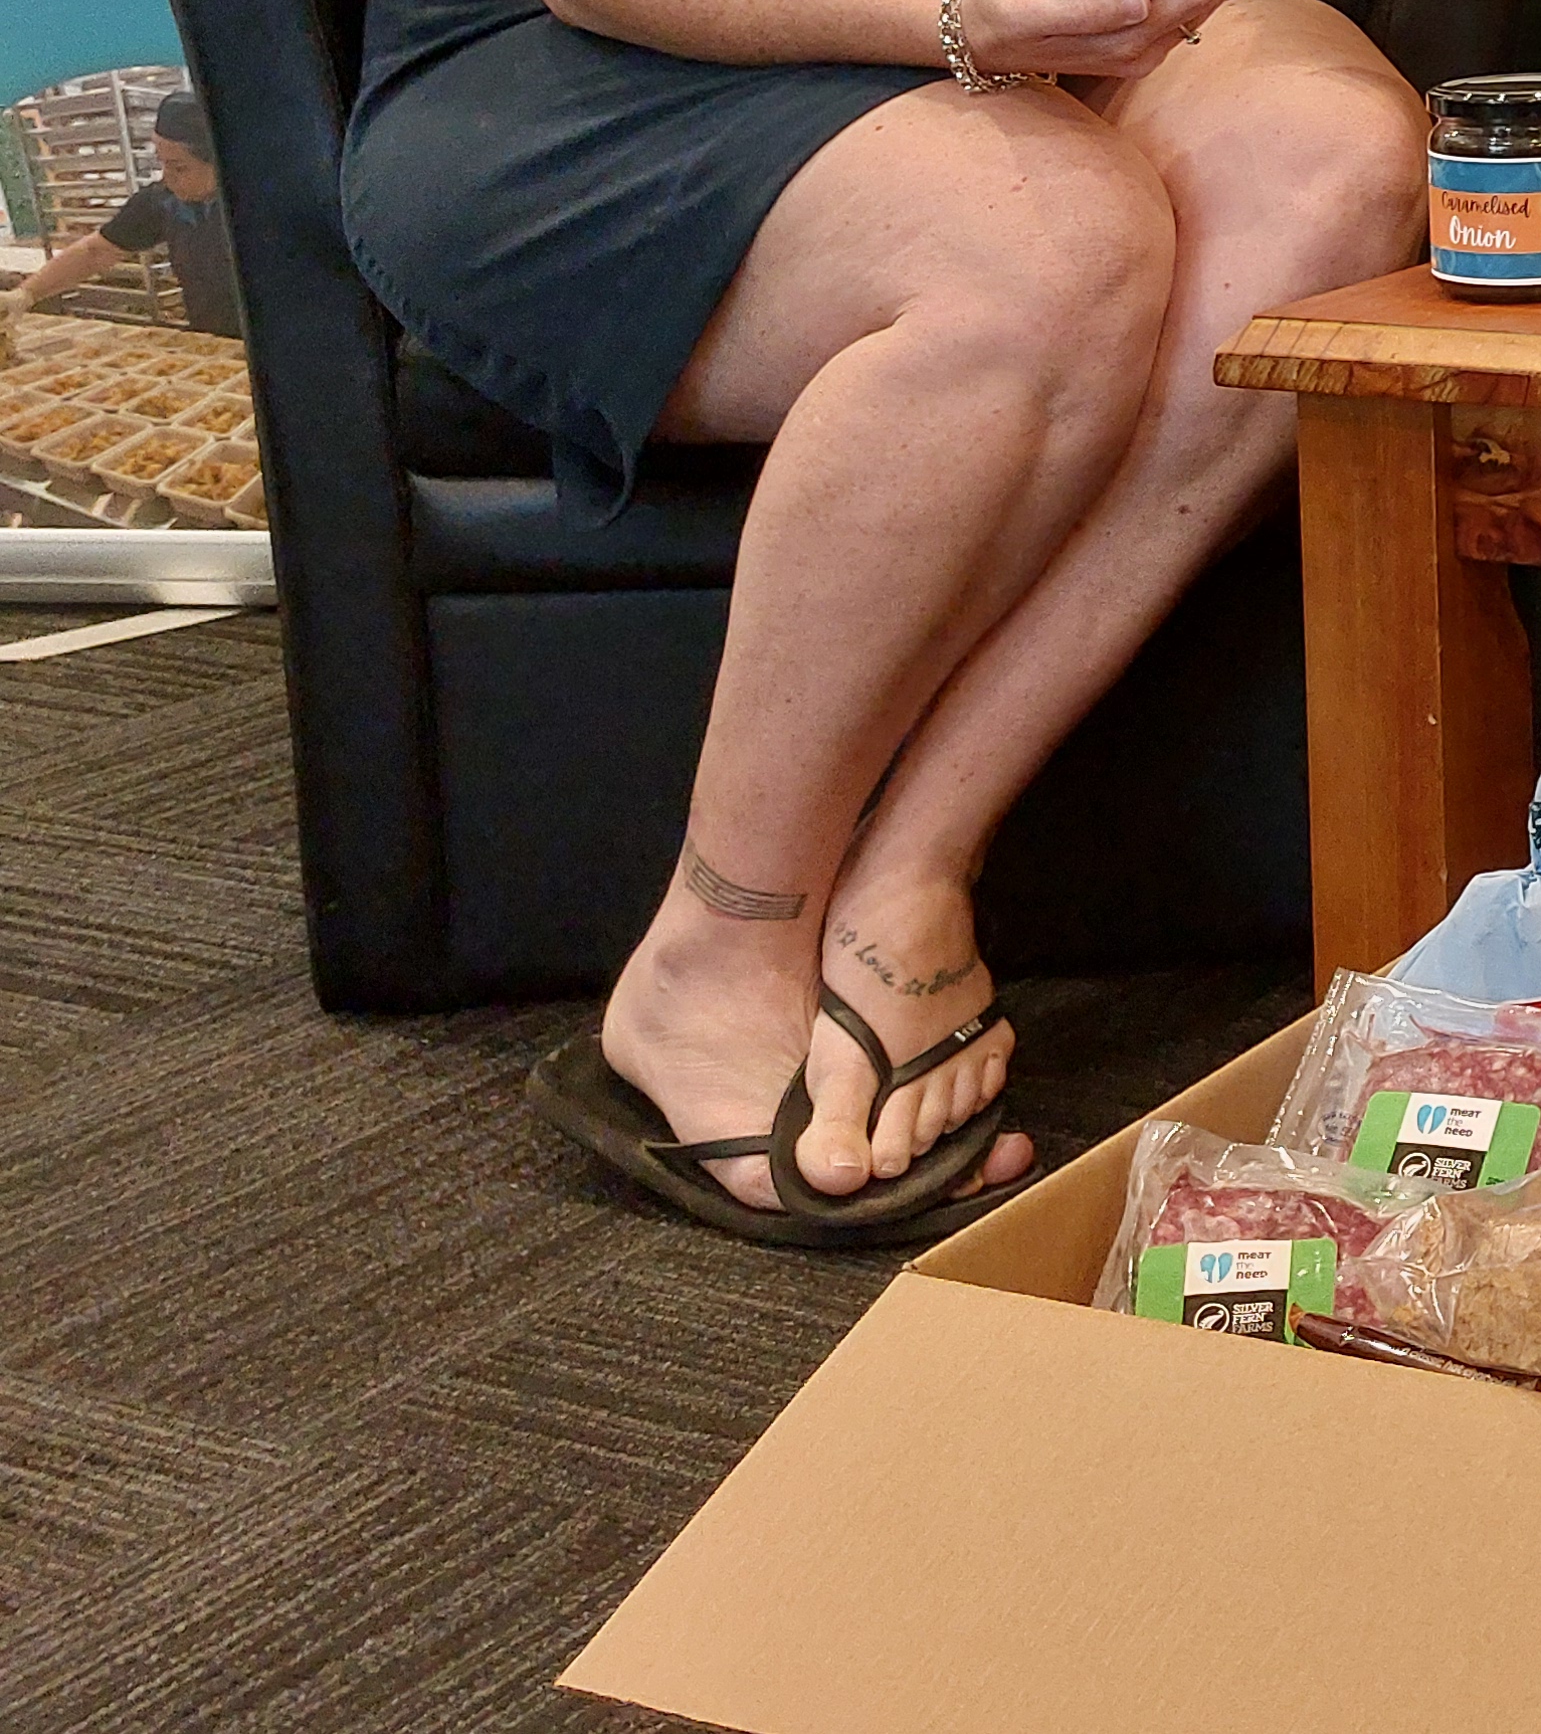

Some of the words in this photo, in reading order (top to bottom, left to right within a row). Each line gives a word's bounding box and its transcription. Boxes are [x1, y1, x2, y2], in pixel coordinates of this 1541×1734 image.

[1441, 190, 1531, 218] Caramelised
[1449, 214, 1517, 250] Onion
[1433, 1156, 1472, 1172] SILVER
[1430, 1167, 1465, 1180] FERN
[1231, 1301, 1275, 1316] SILVER
[1231, 1312, 1266, 1325] FERN
[1230, 1321, 1275, 1335] FARMS
